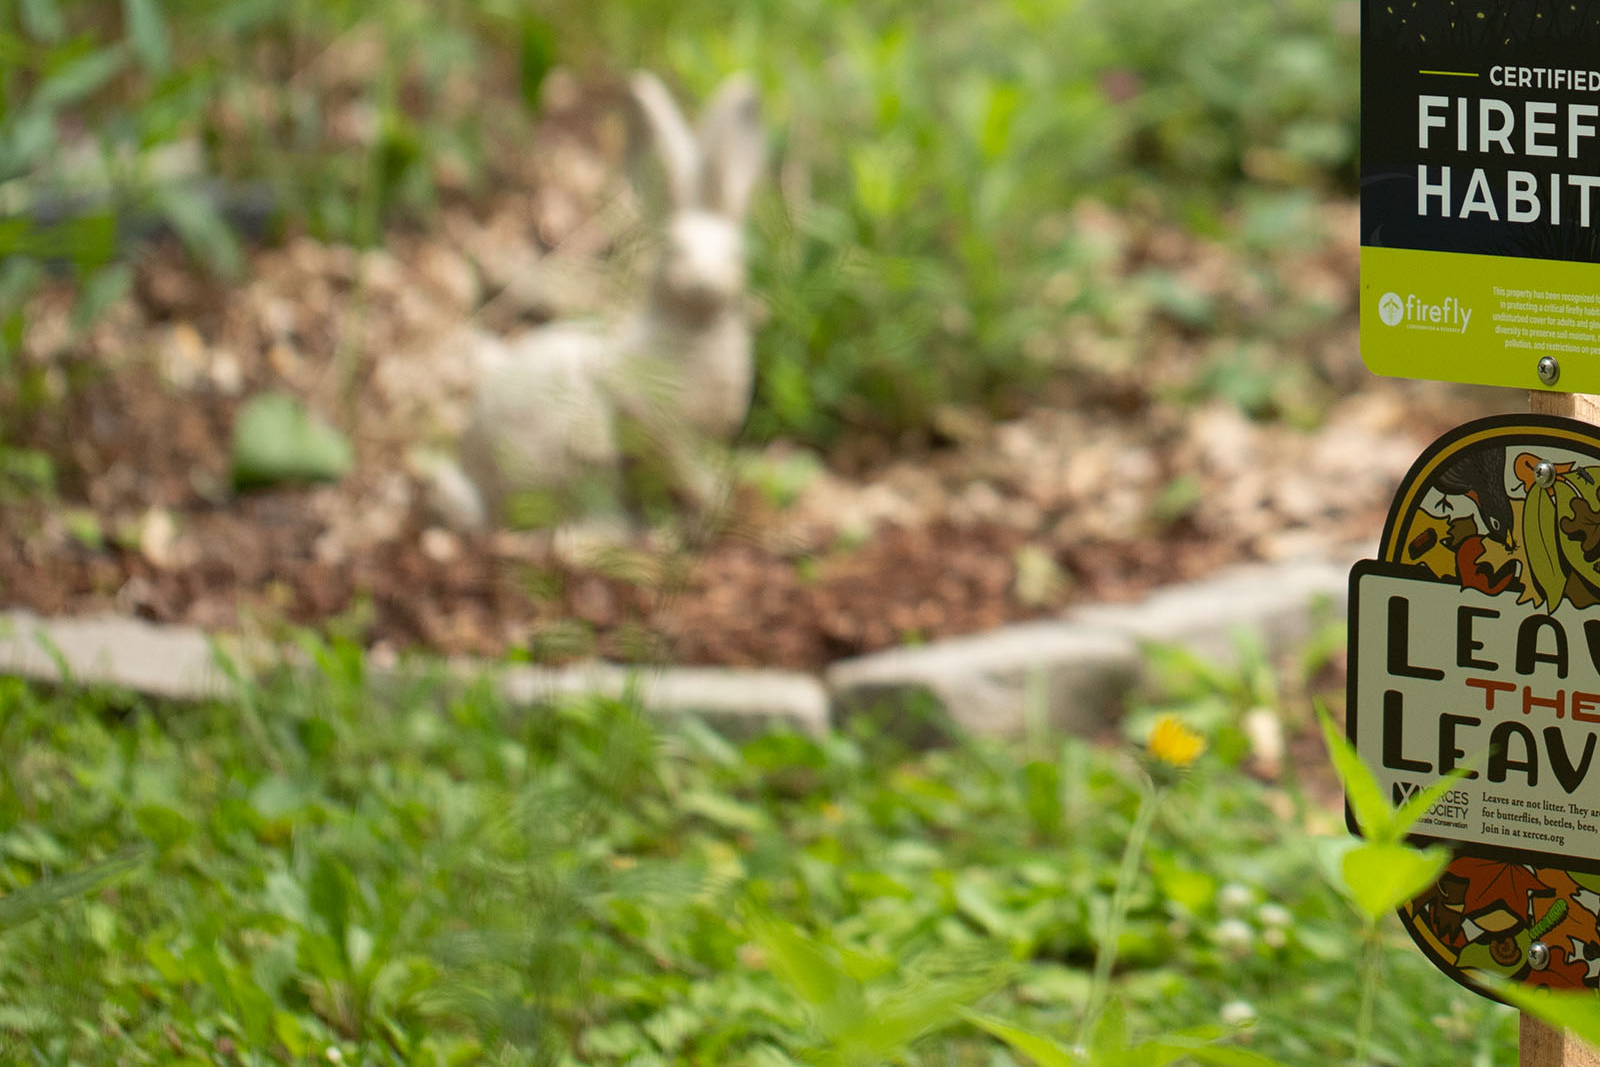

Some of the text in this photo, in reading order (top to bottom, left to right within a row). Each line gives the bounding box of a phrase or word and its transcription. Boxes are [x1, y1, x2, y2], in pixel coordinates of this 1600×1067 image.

[1406, 293, 1473, 334] firefly
[1482, 791, 1510, 805] Leaves
[1511, 798, 1525, 807] are
[1526, 800, 1542, 809] not
[1542, 799, 1567, 813] litter.
[1568, 803, 1590, 819] They
[1481, 806, 1495, 818] for
[1496, 809, 1543, 826] butterflies,
[1543, 815, 1576, 831] beetles,
[1577, 820, 1599, 834] bees,
[1480, 822, 1566, 847] Join in at xerces.org
